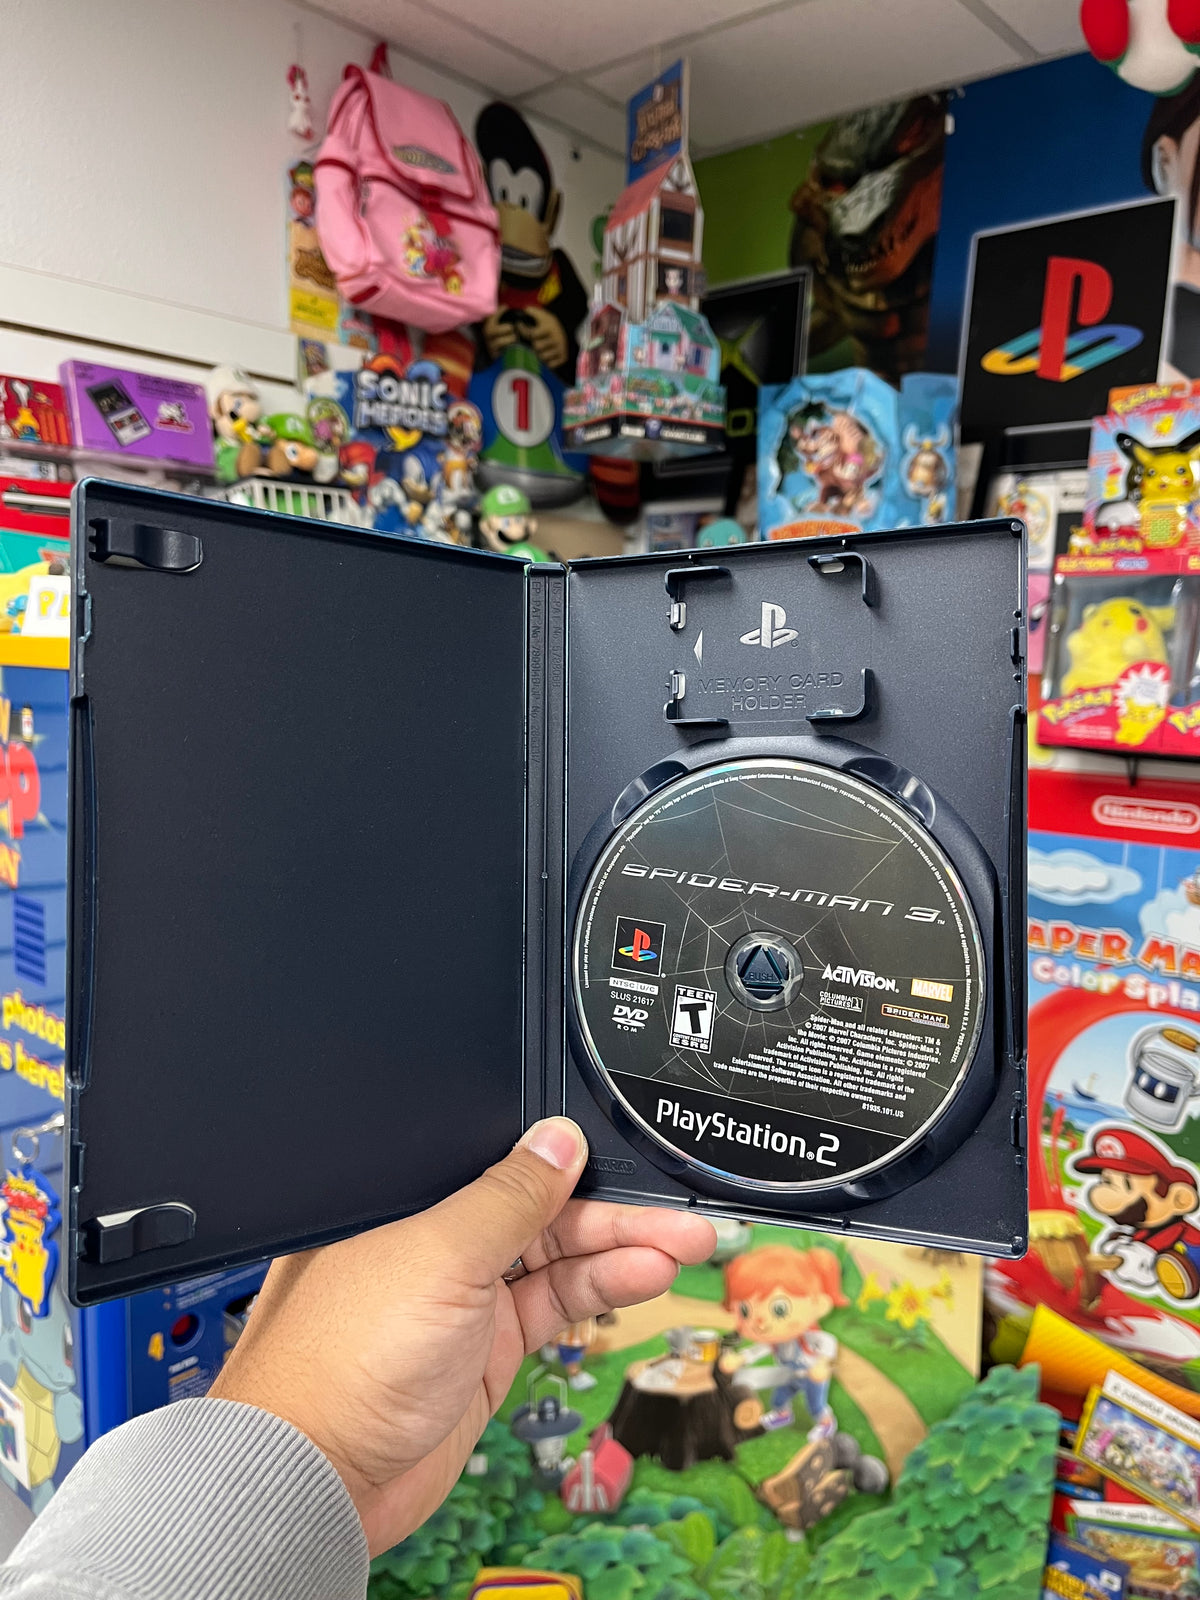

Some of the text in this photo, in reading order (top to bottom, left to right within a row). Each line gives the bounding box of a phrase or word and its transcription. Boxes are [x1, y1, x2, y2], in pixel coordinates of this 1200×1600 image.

[357, 369, 448, 410] SONIC
[512, 378, 529, 431] 1
[698, 672, 844, 694] MEMORY CARD
[731, 694, 806, 712] HOLDER
[1102, 804, 1192, 827] Nintendo
[686, 785, 704, 795] registered
[792, 775, 820, 786] Unauthorized
[879, 811, 893, 823] public
[891, 821, 914, 844] performance
[916, 846, 933, 867] broadcast
[933, 870, 942, 880] this
[938, 879, 948, 892] game
[945, 891, 953, 902] may
[953, 912, 964, 932] violation
[961, 939, 969, 963] applicable
[621, 863, 942, 923] SPIDER-MAN 3
[1028, 919, 1200, 980] APER MA
[612, 980, 655, 993] NTSC U/C
[678, 988, 714, 1001] TEEN
[820, 990, 852, 1002] COLUMBIA
[912, 980, 951, 1001] MARVEL
[1032, 958, 1200, 1009] Color Spla
[610, 990, 654, 1006] SLUS 21617
[820, 998, 852, 1008] PICTURES
[613, 1004, 648, 1020] DVD
[680, 1003, 707, 1034] T
[810, 1012, 843, 1026] Spider-Man
[866, 1025, 886, 1034] related
[617, 1024, 638, 1032] ROM
[828, 1026, 847, 1036] Marvel
[898, 1040, 933, 1054] Spider-Man
[672, 1038, 709, 1050] ESRB
[810, 1040, 825, 1049] rights
[856, 1049, 873, 1058] Game
[915, 1061, 929, 1070] 2007
[836, 1037, 850, 1045] 2007
[852, 1040, 880, 1051] Columbia
[882, 1046, 905, 1056] Pictures
[763, 1048, 791, 1059] trademark
[799, 1055, 827, 1066] Activision
[886, 1073, 903, 1083] rights
[776, 1042, 803, 1053] Activision
[852, 1057, 880, 1069] Activision
[895, 1066, 925, 1078] registered
[713, 1062, 727, 1070] trade
[728, 1066, 745, 1074] names
[768, 1074, 796, 1086] properties
[805, 1082, 819, 1090] their
[819, 1085, 849, 1098] respective
[732, 1057, 769, 1071] Entertainment
[771, 1066, 795, 1076] Software
[843, 1082, 858, 1090] other
[859, 1084, 893, 1097] trademarks
[787, 1061, 807, 1071] ratings
[834, 1071, 863, 1083] registered
[865, 1078, 895, 1089] trademark
[862, 1103, 903, 1117] 81935.101.US
[816, 1132, 840, 1166] 2
